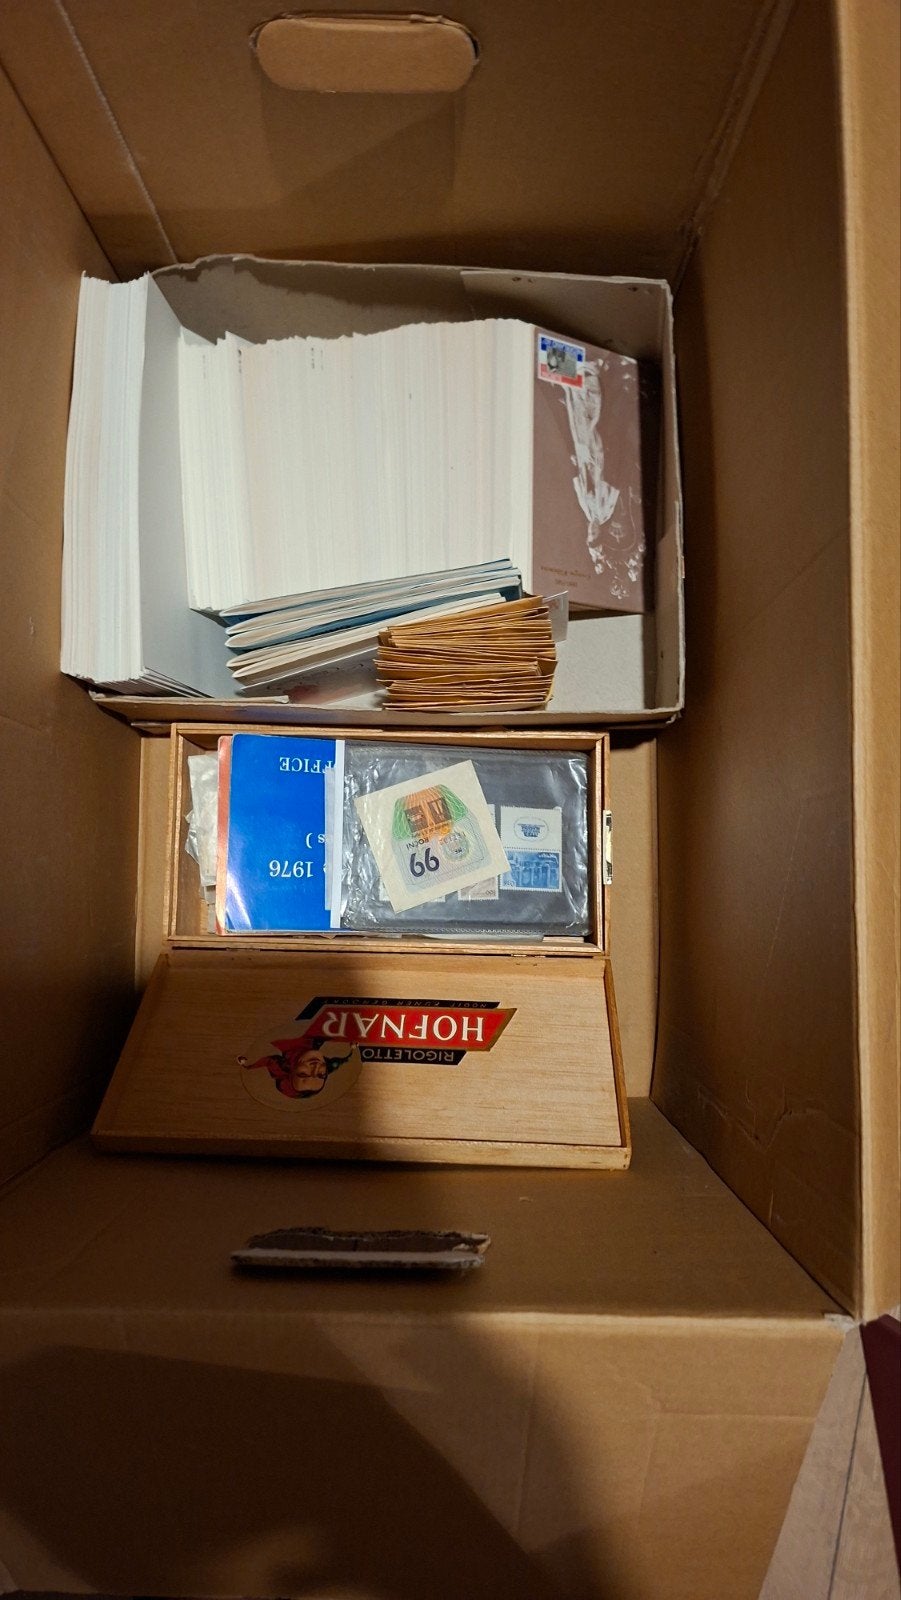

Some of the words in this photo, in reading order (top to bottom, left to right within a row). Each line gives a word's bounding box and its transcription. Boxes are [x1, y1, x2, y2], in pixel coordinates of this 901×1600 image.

[279, 757, 336, 773] FFICE
[269, 860, 314, 878] 1976
[410, 848, 440, 877] 99
[321, 1012, 484, 1042] HOFNAR
[362, 1048, 454, 1062] RIGOLETTO
